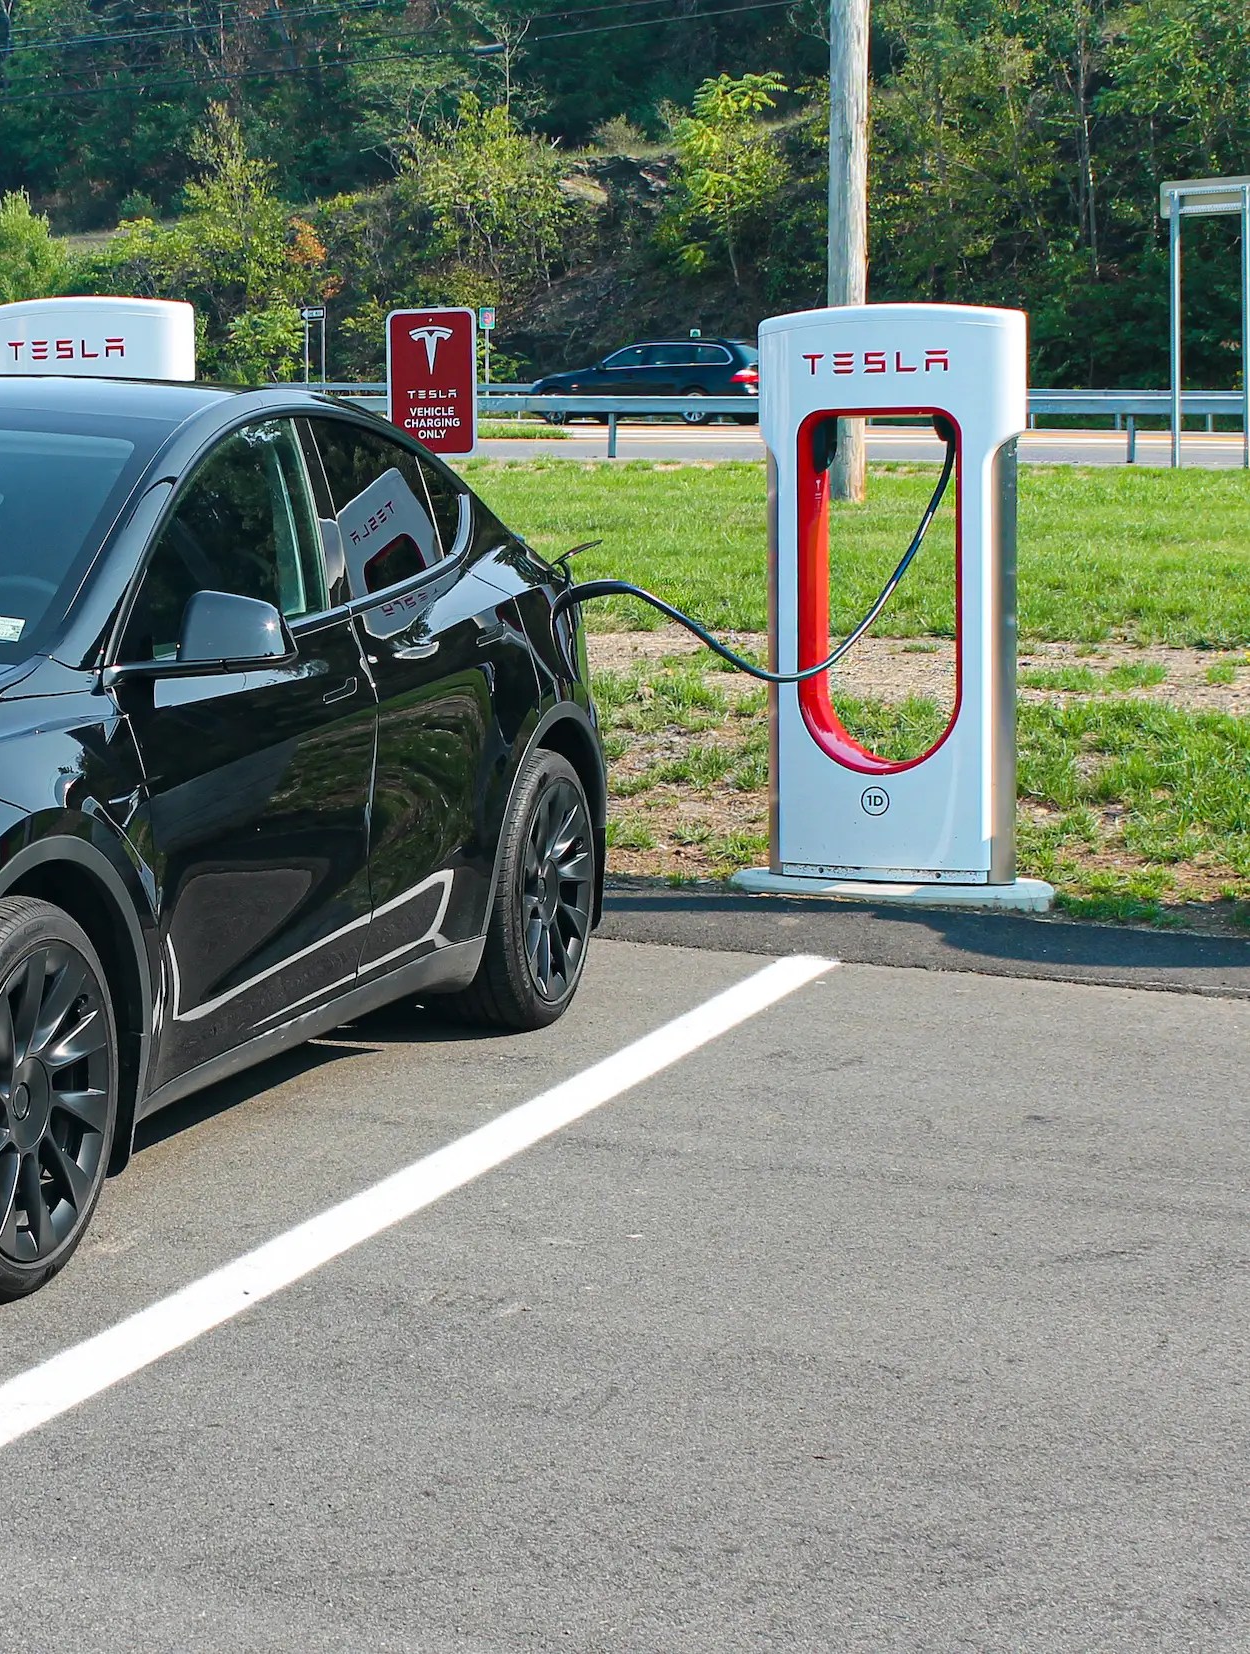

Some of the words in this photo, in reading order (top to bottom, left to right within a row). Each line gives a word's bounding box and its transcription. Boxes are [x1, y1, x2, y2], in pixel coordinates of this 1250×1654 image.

[7, 338, 125, 361] TESLA
[802, 349, 949, 375] TESLA
[407, 389, 457, 399] TESLA
[410, 406, 454, 417] VEHICLE
[404, 418, 461, 428] CHARGING
[418, 429, 447, 440] ONLY
[866, 795, 883, 806] 1D
